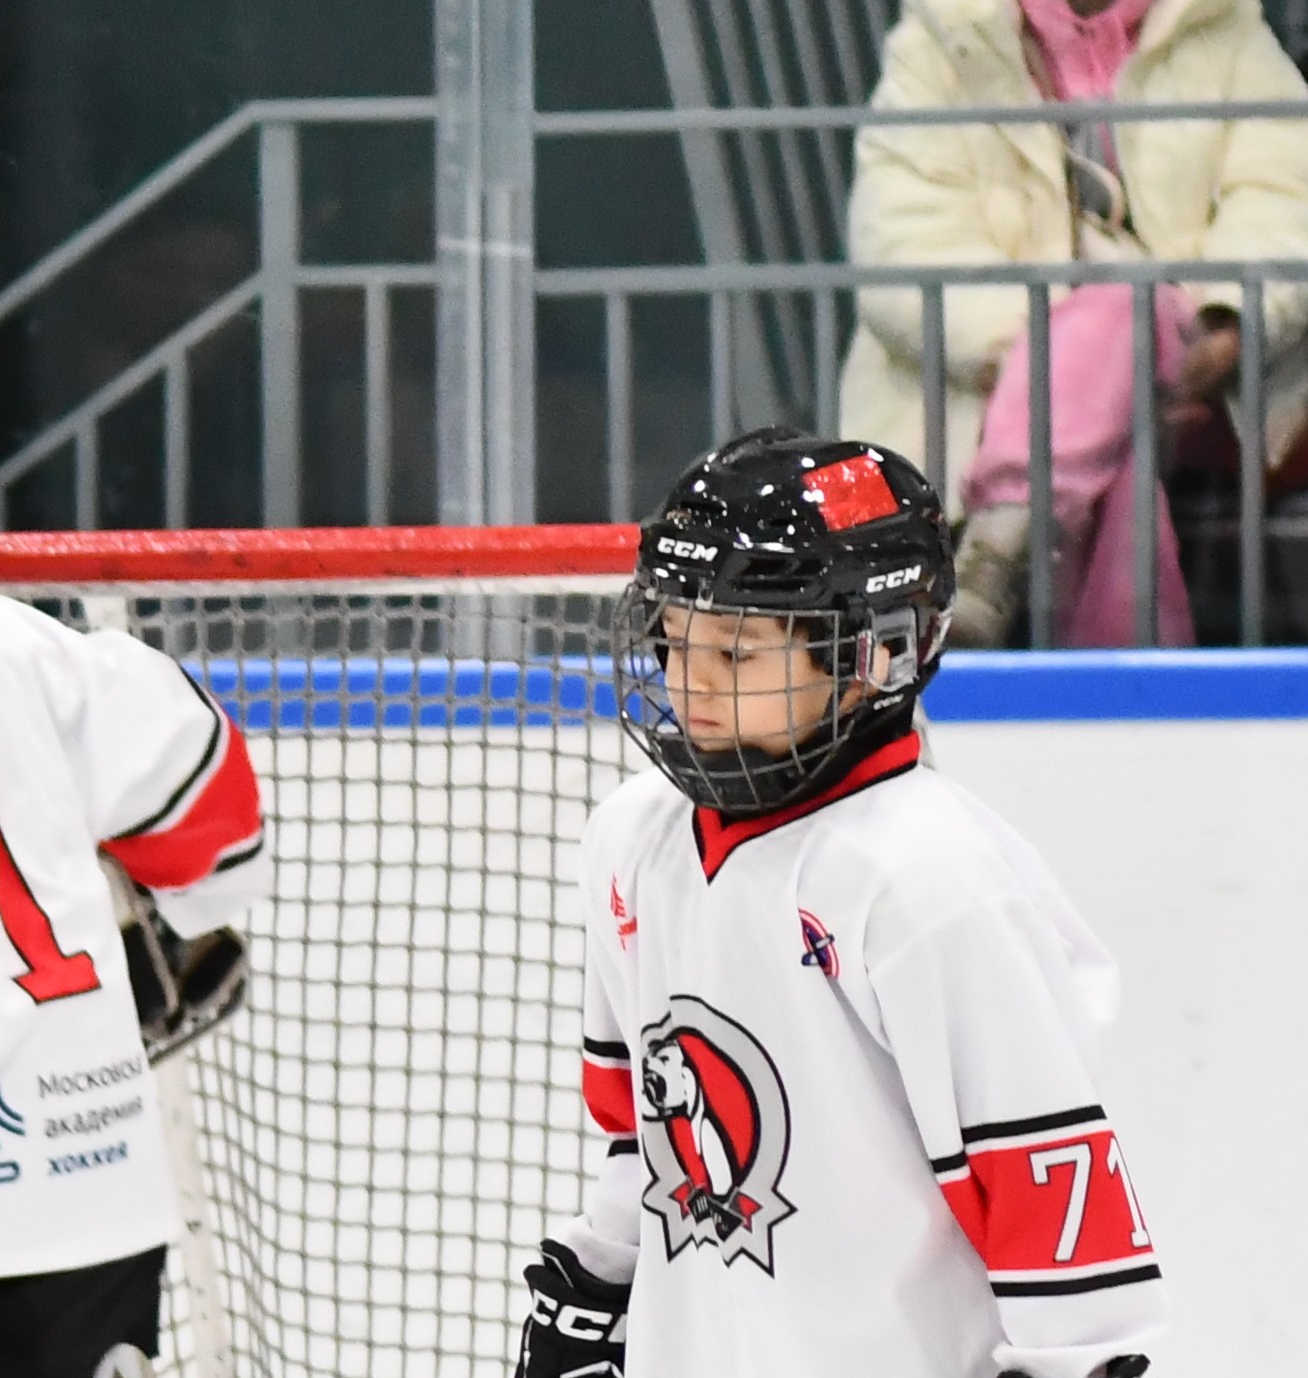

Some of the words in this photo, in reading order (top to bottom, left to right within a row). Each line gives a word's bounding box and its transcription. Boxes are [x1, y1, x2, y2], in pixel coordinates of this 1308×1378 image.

[656, 536, 718, 563] CCM
[865, 564, 922, 594] CCM
[1029, 1134, 1153, 1264] 71
